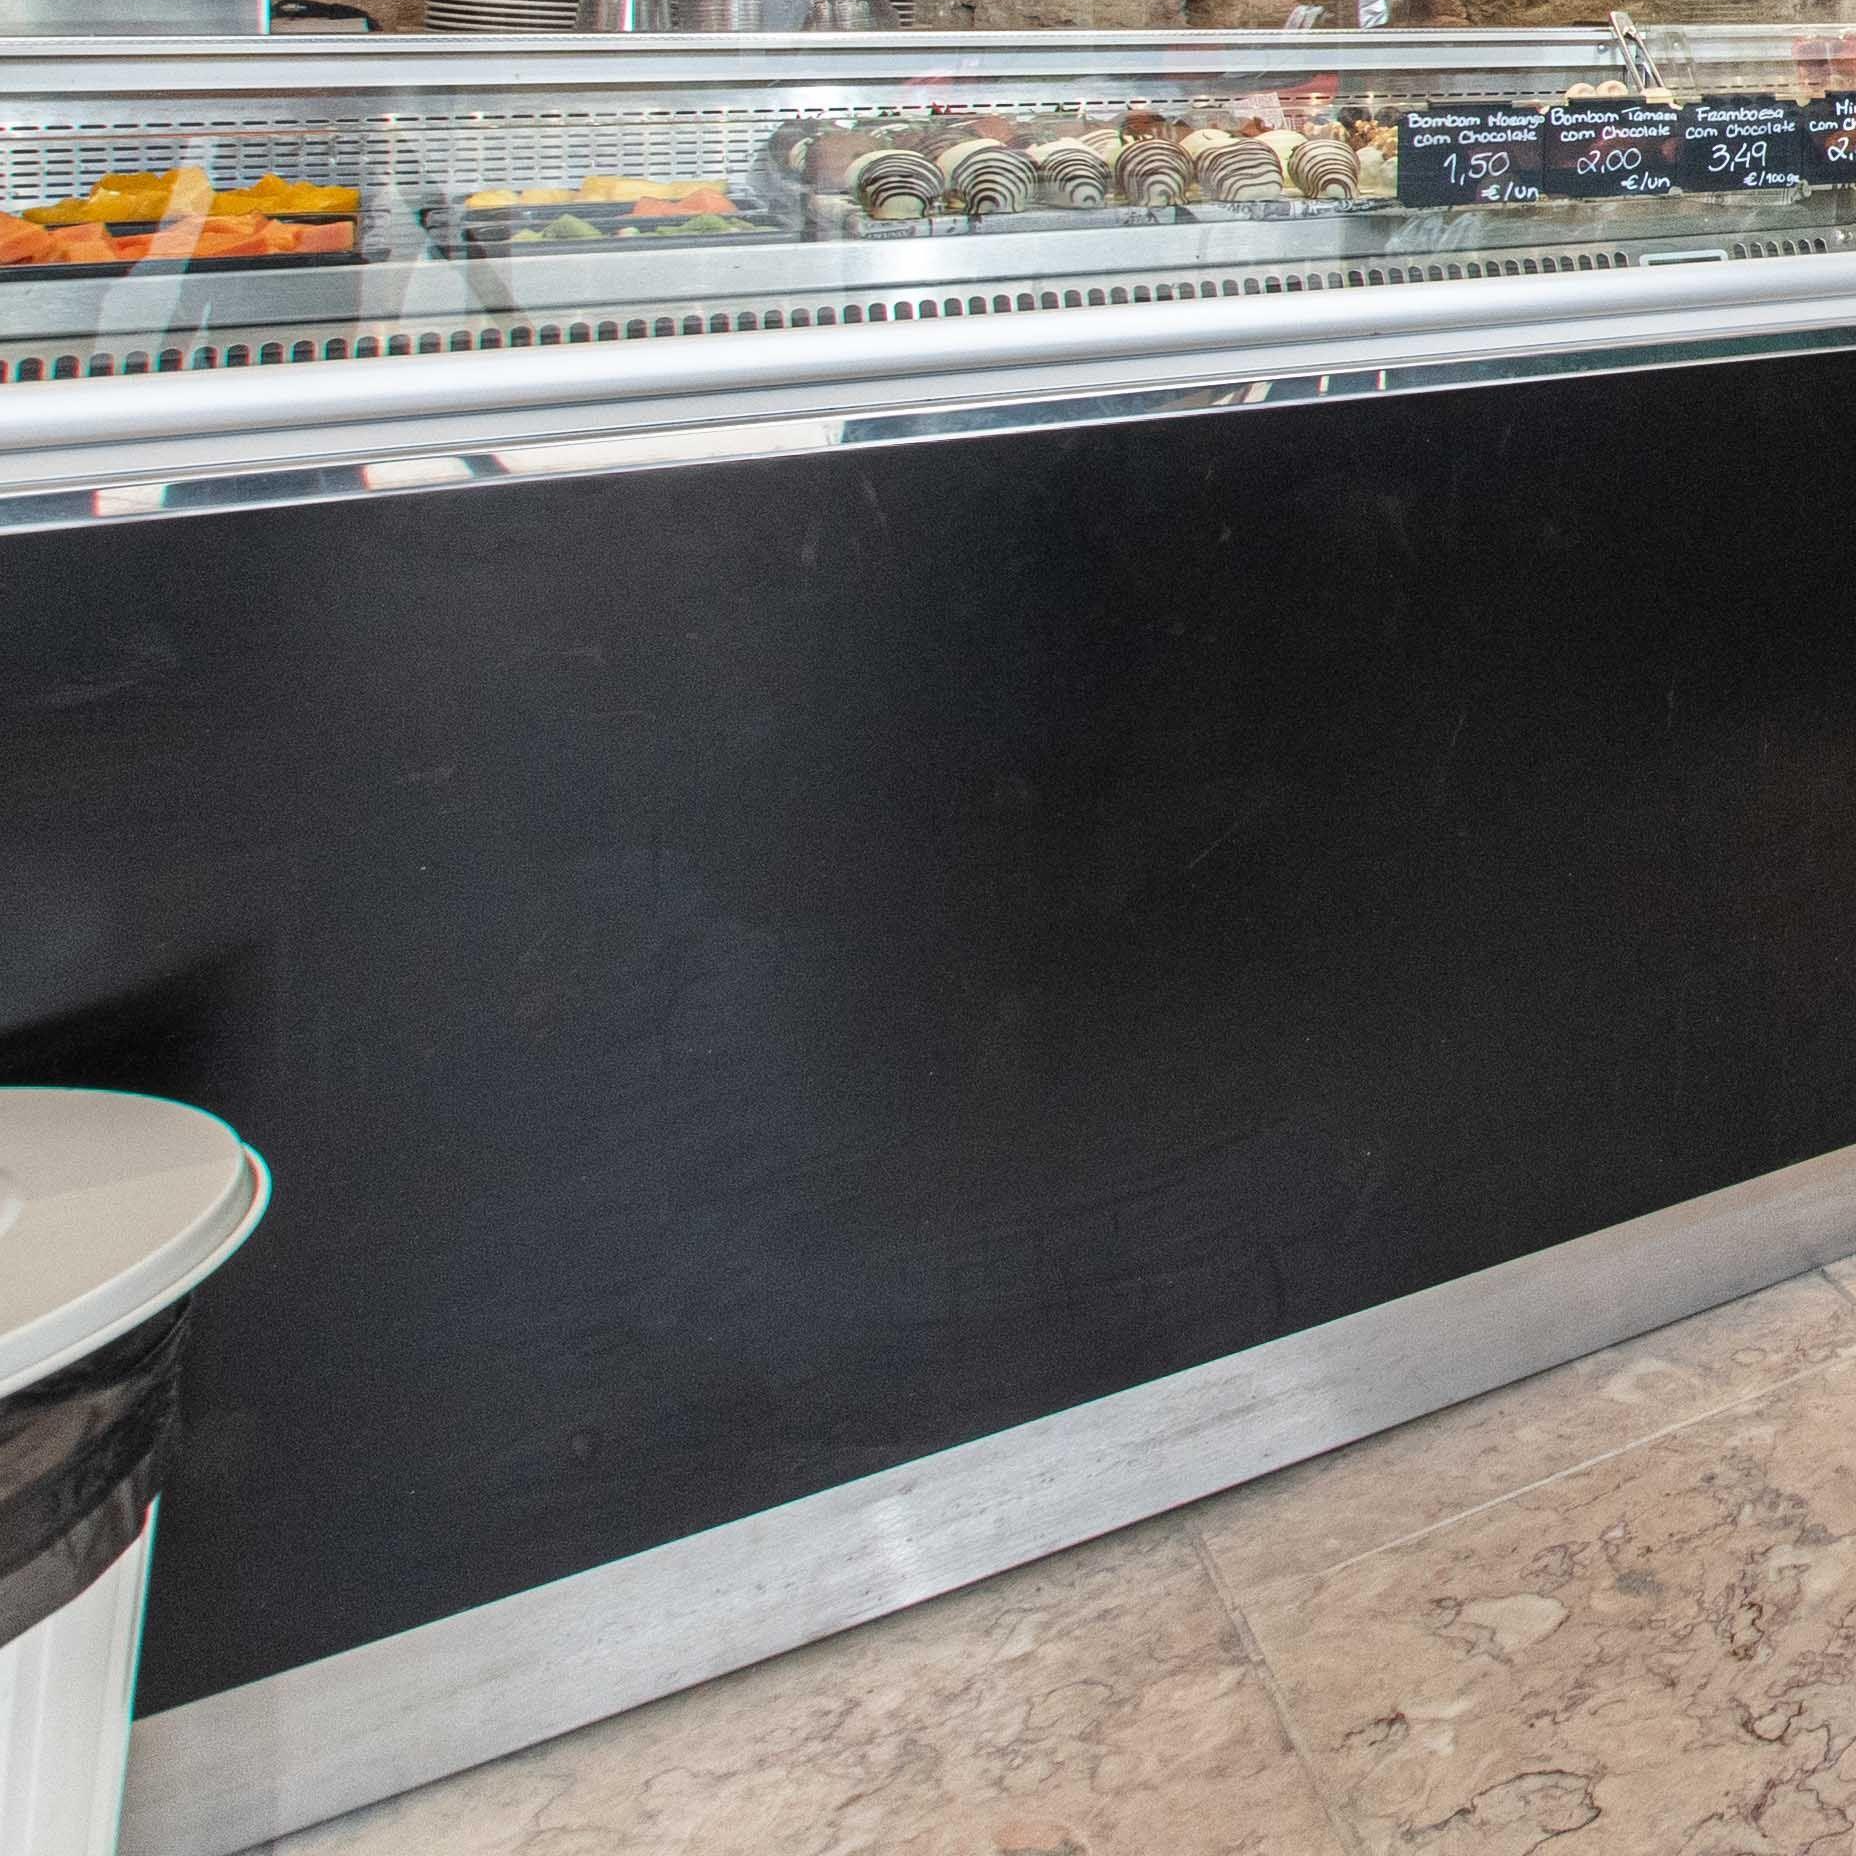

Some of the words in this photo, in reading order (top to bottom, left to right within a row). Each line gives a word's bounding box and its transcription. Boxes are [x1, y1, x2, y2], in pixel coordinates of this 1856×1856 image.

[1408, 112, 1481, 129] Bombom
[1551, 109, 1619, 126] Bombom
[1809, 119, 1839, 132] com
[1414, 134, 1451, 148] com
[1459, 129, 1538, 144] Chocolate
[1561, 128, 1596, 142] com
[1602, 124, 1671, 139] Chocolate
[1685, 127, 1718, 140] com
[1726, 120, 1796, 137] Chocolate
[1577, 148, 1642, 175] 2,00
[1708, 141, 1768, 172] 3,49
[1443, 151, 1511, 186] 1,50
[1481, 181, 1540, 201] €/un
[1621, 171, 1671, 192] €/un
